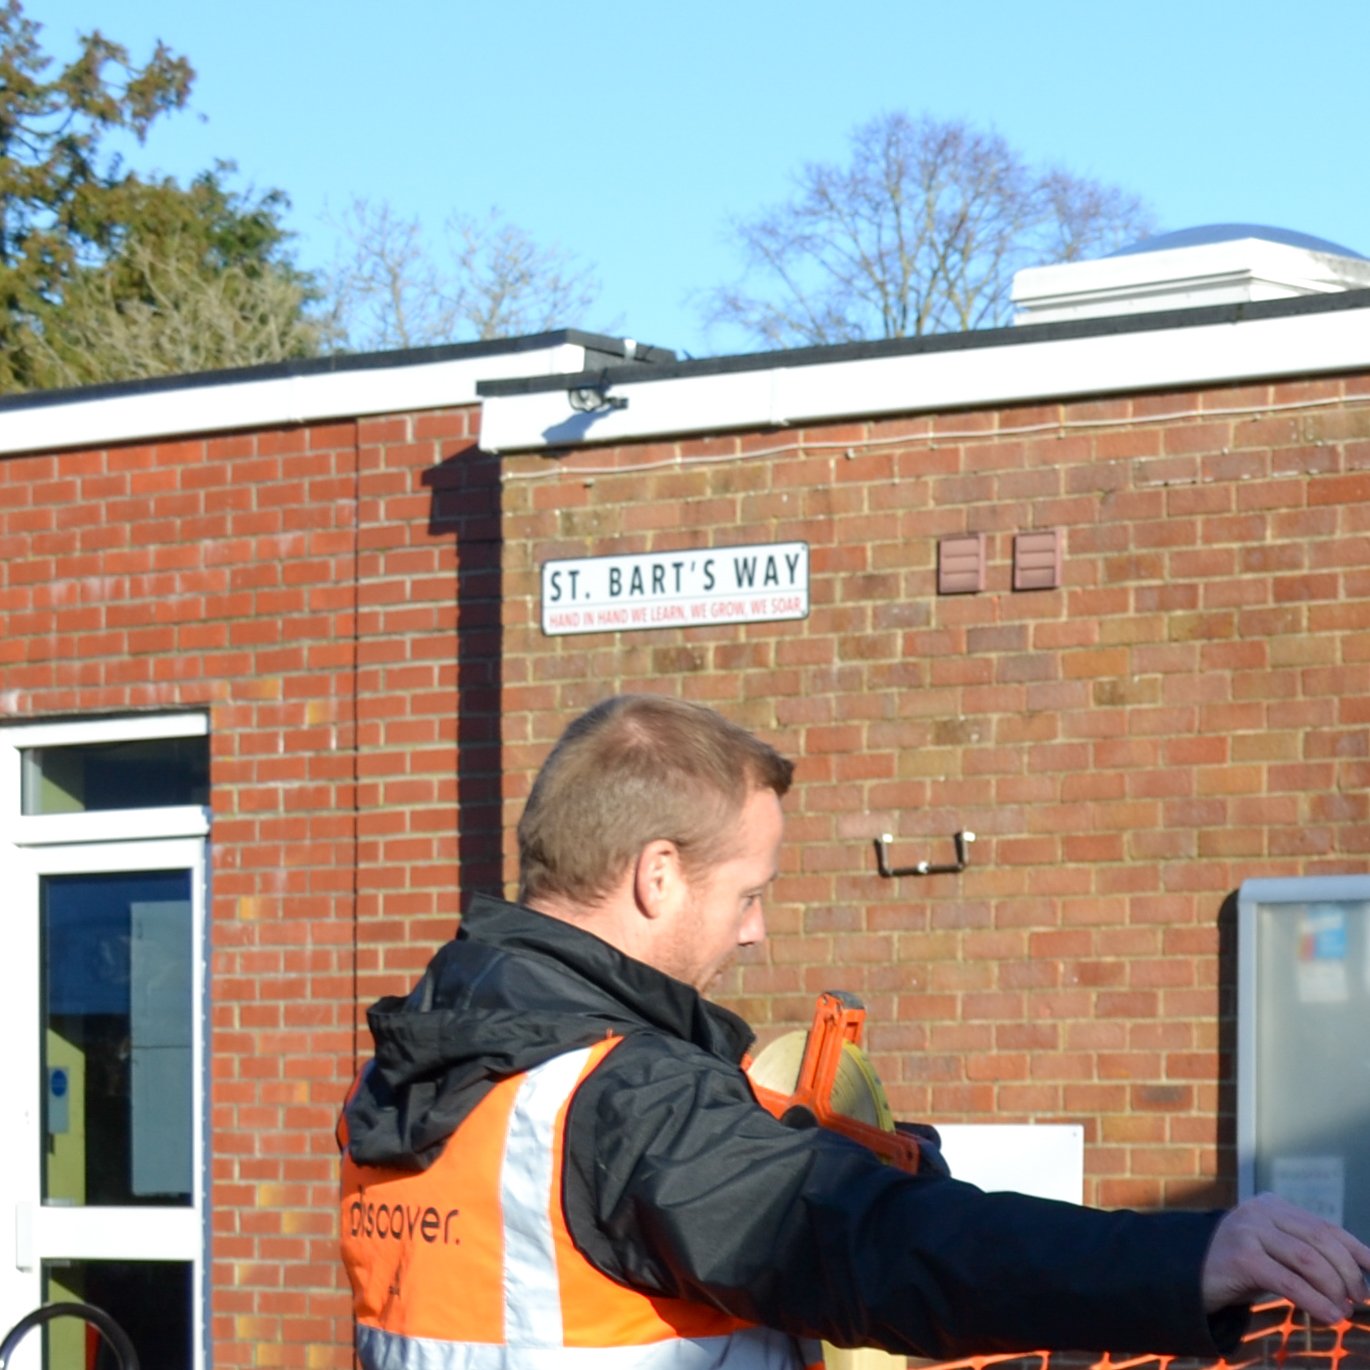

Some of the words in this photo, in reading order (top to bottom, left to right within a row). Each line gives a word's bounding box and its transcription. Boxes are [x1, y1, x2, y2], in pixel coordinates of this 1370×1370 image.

[550, 570, 591, 601] ST.
[609, 559, 715, 597] BART'S
[734, 553, 799, 588] WAY
[550, 612, 580, 627] HAND
[584, 612, 594, 625] IN
[597, 608, 628, 623] HAND
[631, 607, 647, 622] WE
[691, 603, 706, 618] WE
[751, 599, 767, 614] WE
[772, 597, 801, 614] SOAR
